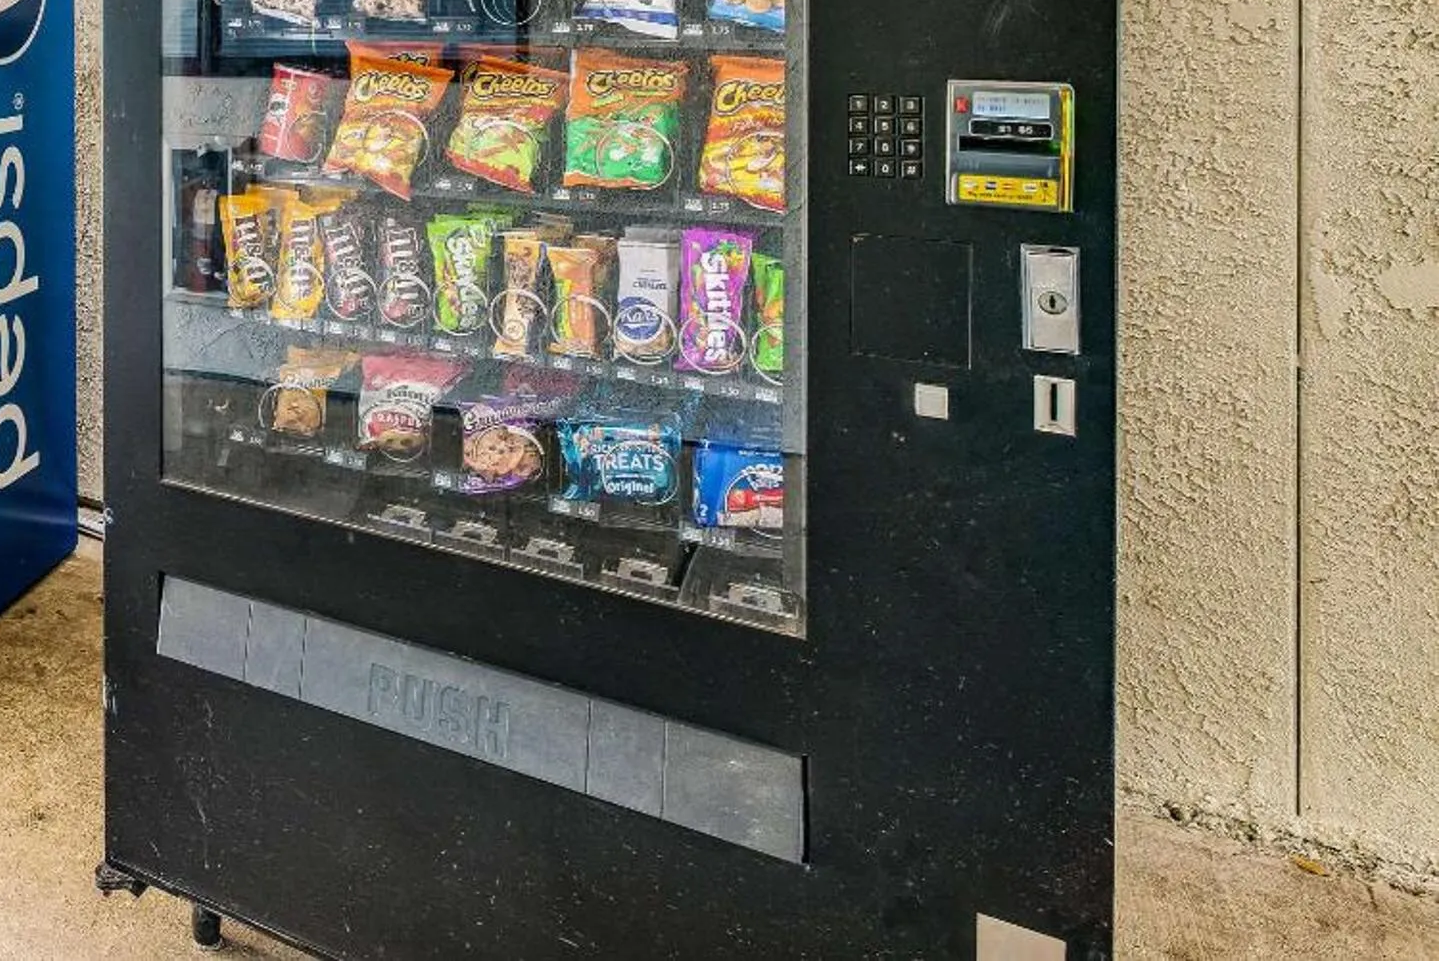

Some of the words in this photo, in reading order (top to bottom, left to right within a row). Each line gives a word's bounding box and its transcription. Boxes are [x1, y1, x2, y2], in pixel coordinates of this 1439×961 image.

[354, 69, 433, 103] Cheetos
[471, 70, 559, 100] Cheetos
[586, 69, 679, 97] Cheetos
[700, 250, 732, 363] Skittles
[592, 453, 665, 472] TREATS
[699, 503, 709, 517] 2
[367, 661, 511, 759] PUSH
